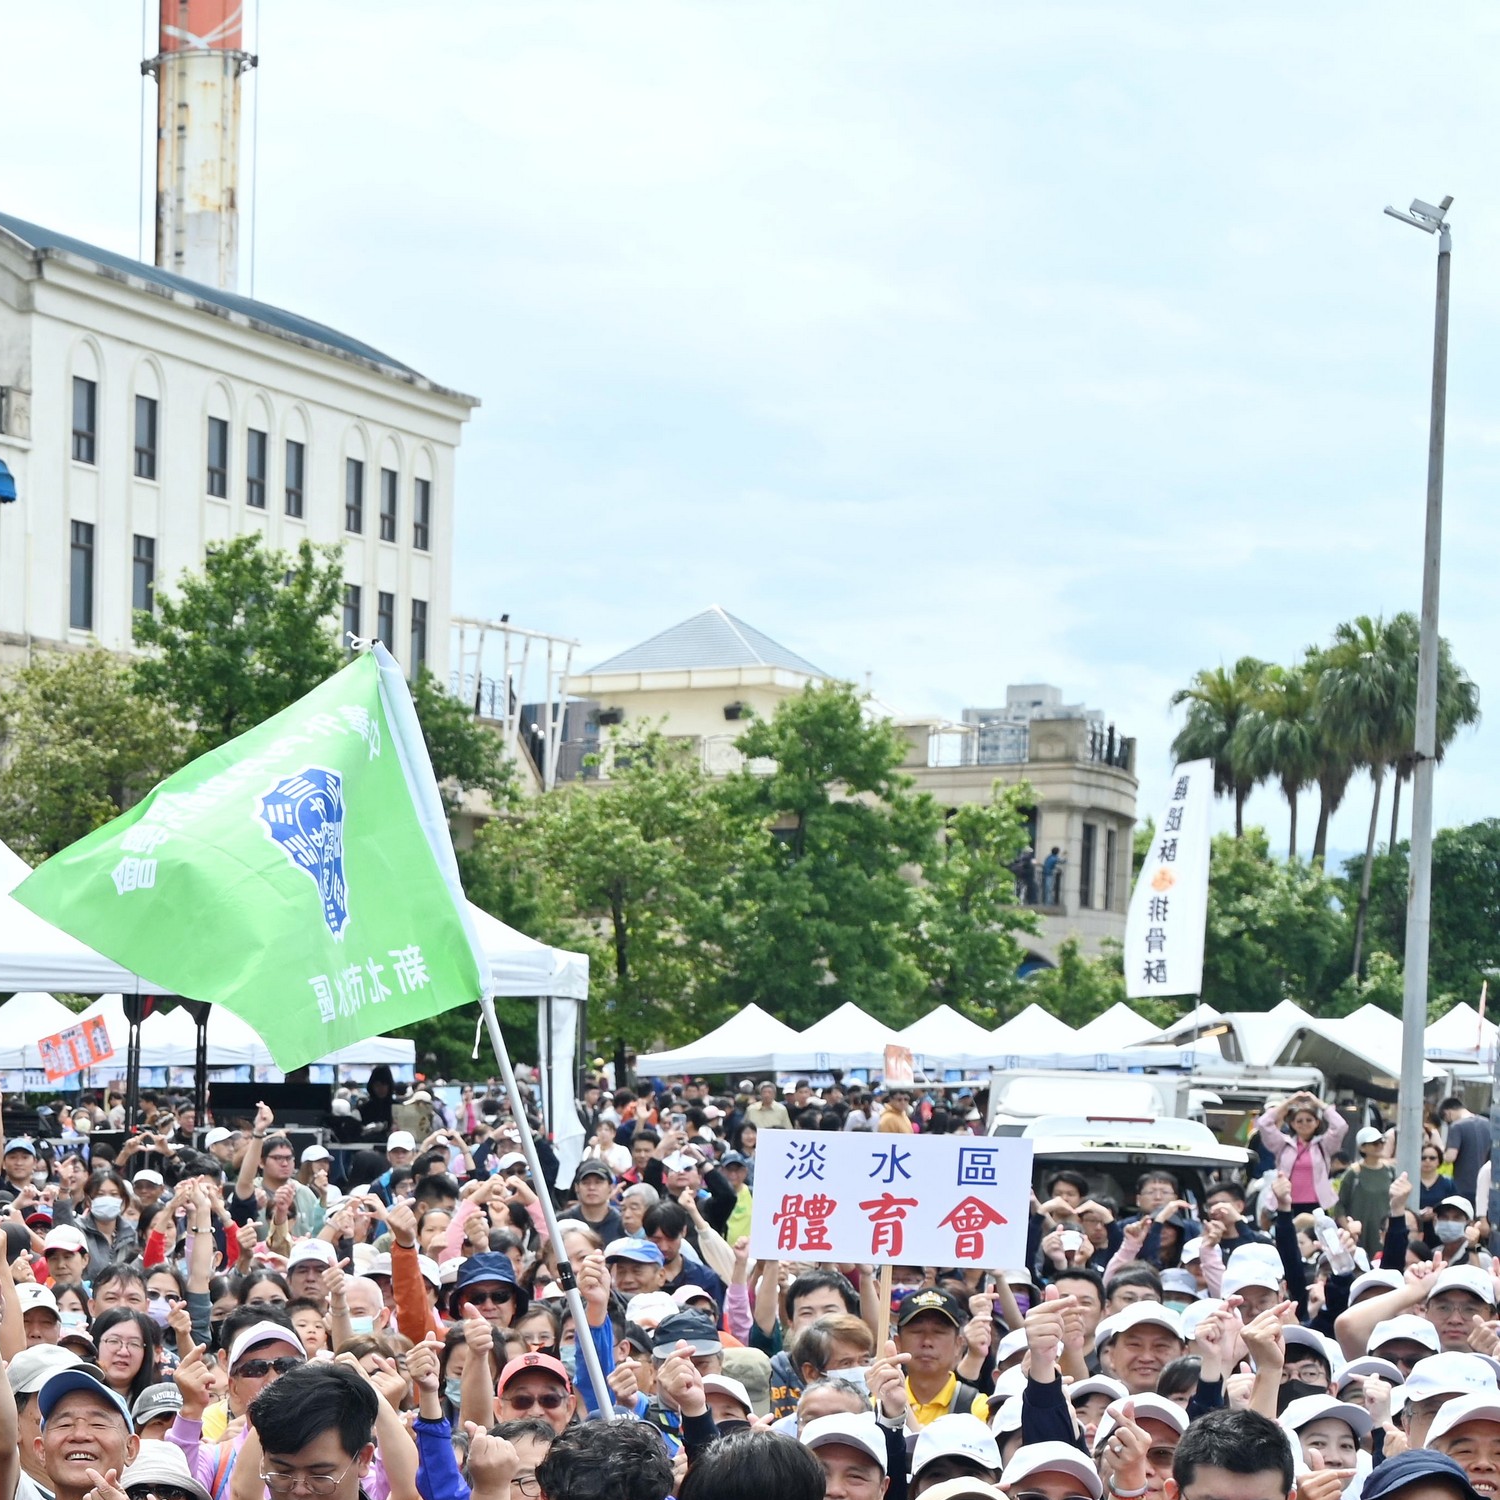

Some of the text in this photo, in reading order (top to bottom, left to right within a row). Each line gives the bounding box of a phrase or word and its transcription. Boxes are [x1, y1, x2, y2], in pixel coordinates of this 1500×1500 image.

[784, 1141, 999, 1188] 淡水區
[772, 1191, 1009, 1260] 體育會
